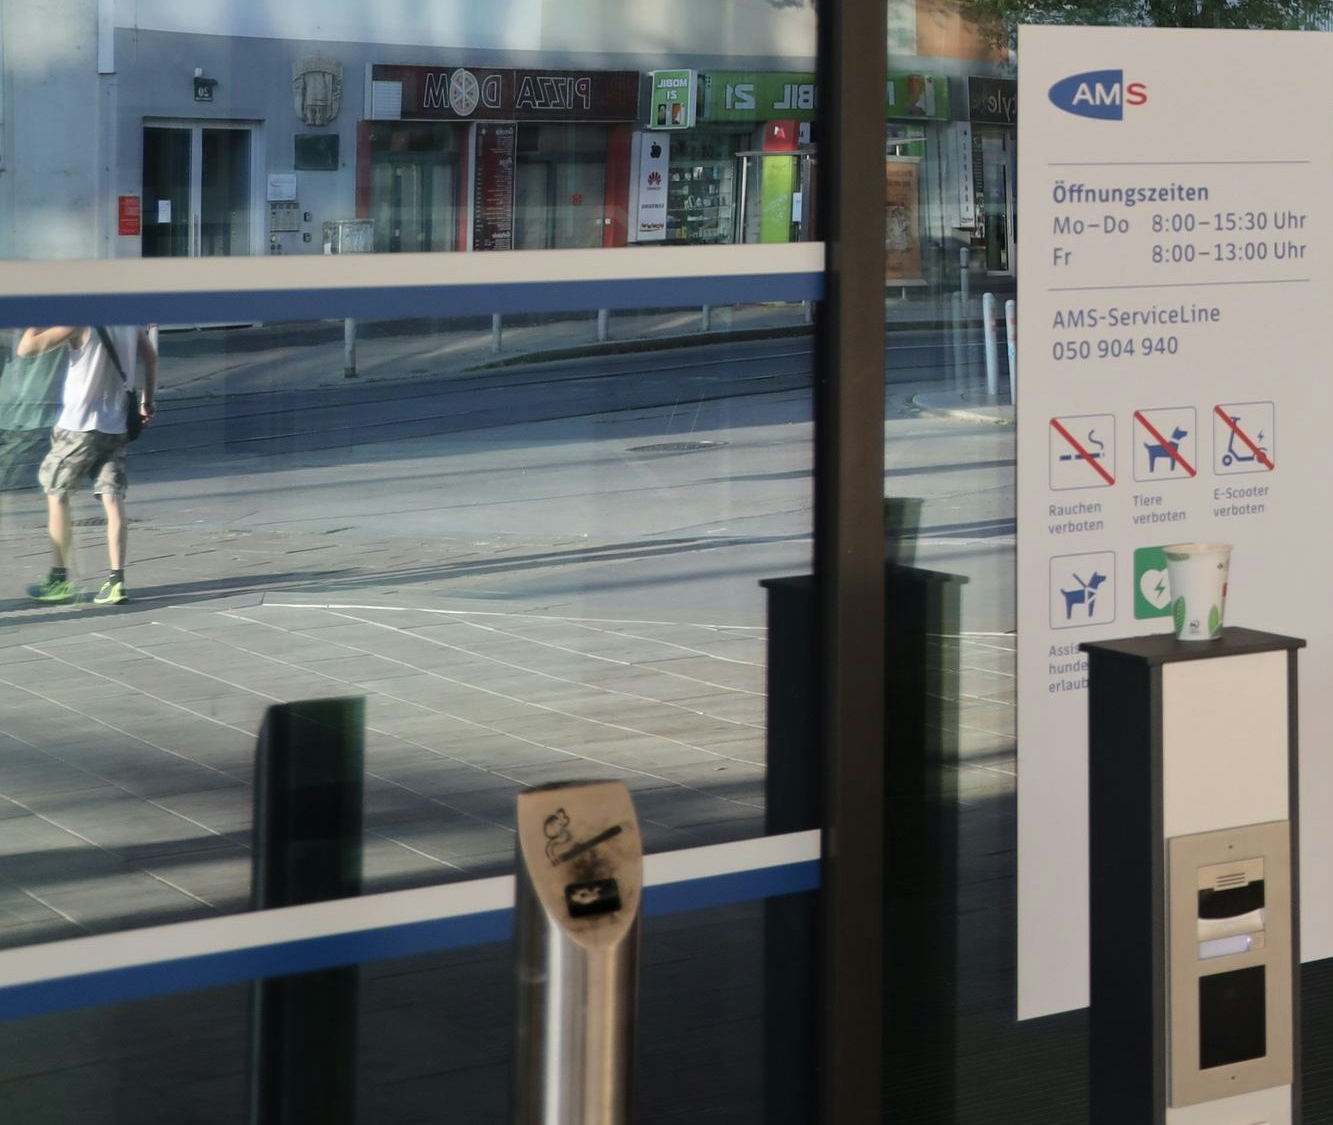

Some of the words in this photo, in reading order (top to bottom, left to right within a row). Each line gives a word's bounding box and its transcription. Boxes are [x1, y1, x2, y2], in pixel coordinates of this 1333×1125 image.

[1071, 82, 1148, 106] AMS
[1052, 180, 1209, 207] Öffnungszeiten
[1273, 210, 1307, 230] Uhr
[1053, 247, 1072, 266] Fr
[1273, 241, 1307, 260] Uhr
[1052, 304, 1221, 329] AMS-ServiceLine
[1053, 341, 1091, 361] 050
[1097, 338, 1136, 358] 904
[1141, 336, 1179, 356] 940
[1133, 493, 1163, 507] Tiere
[1213, 484, 1270, 501] E-Scooter
[1049, 501, 1102, 517] Rauchen
[1132, 509, 1187, 525] verboten
[1213, 502, 1265, 518] verboten
[1048, 518, 1104, 535] verboten
[1049, 644, 1080, 656] Assis
[1048, 677, 1088, 693] erlaub
